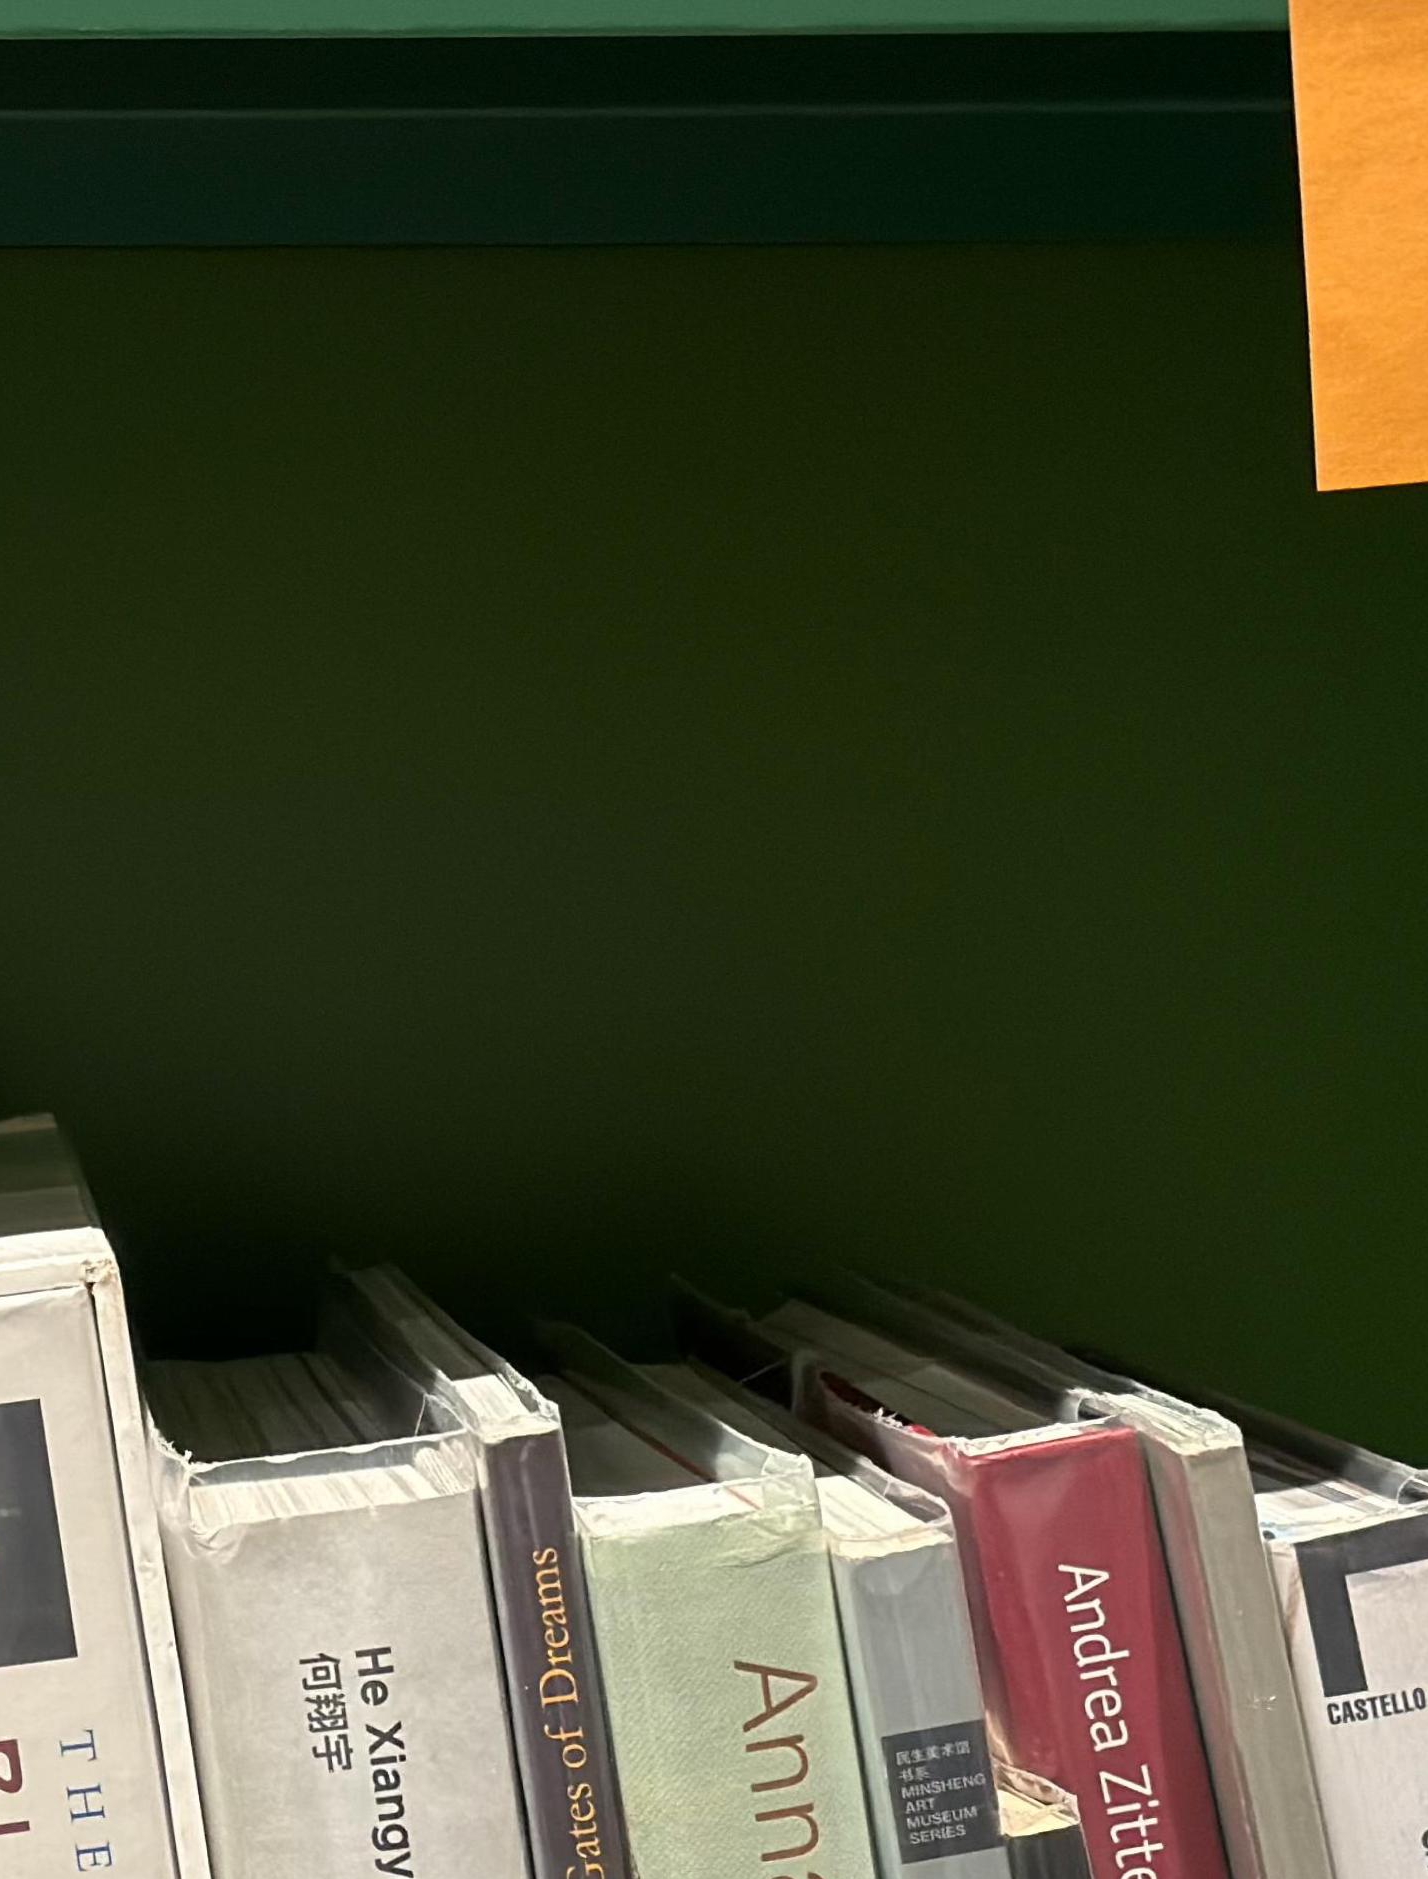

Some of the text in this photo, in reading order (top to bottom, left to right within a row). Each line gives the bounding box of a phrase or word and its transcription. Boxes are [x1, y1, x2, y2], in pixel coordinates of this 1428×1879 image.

[531, 1546, 580, 1709] Dreams
[354, 1645, 394, 1709] He
[1058, 1563, 1129, 1753] Andrea
[298, 1651, 354, 1773] 何翔宇
[543, 1723, 588, 1770] of
[57, 1729, 113, 1873] THE
[900, 1772, 987, 1800] MINSHENG
[904, 1797, 937, 1814] ART
[906, 1804, 979, 1829] MUSEUM
[908, 1823, 967, 1845] SERIES
